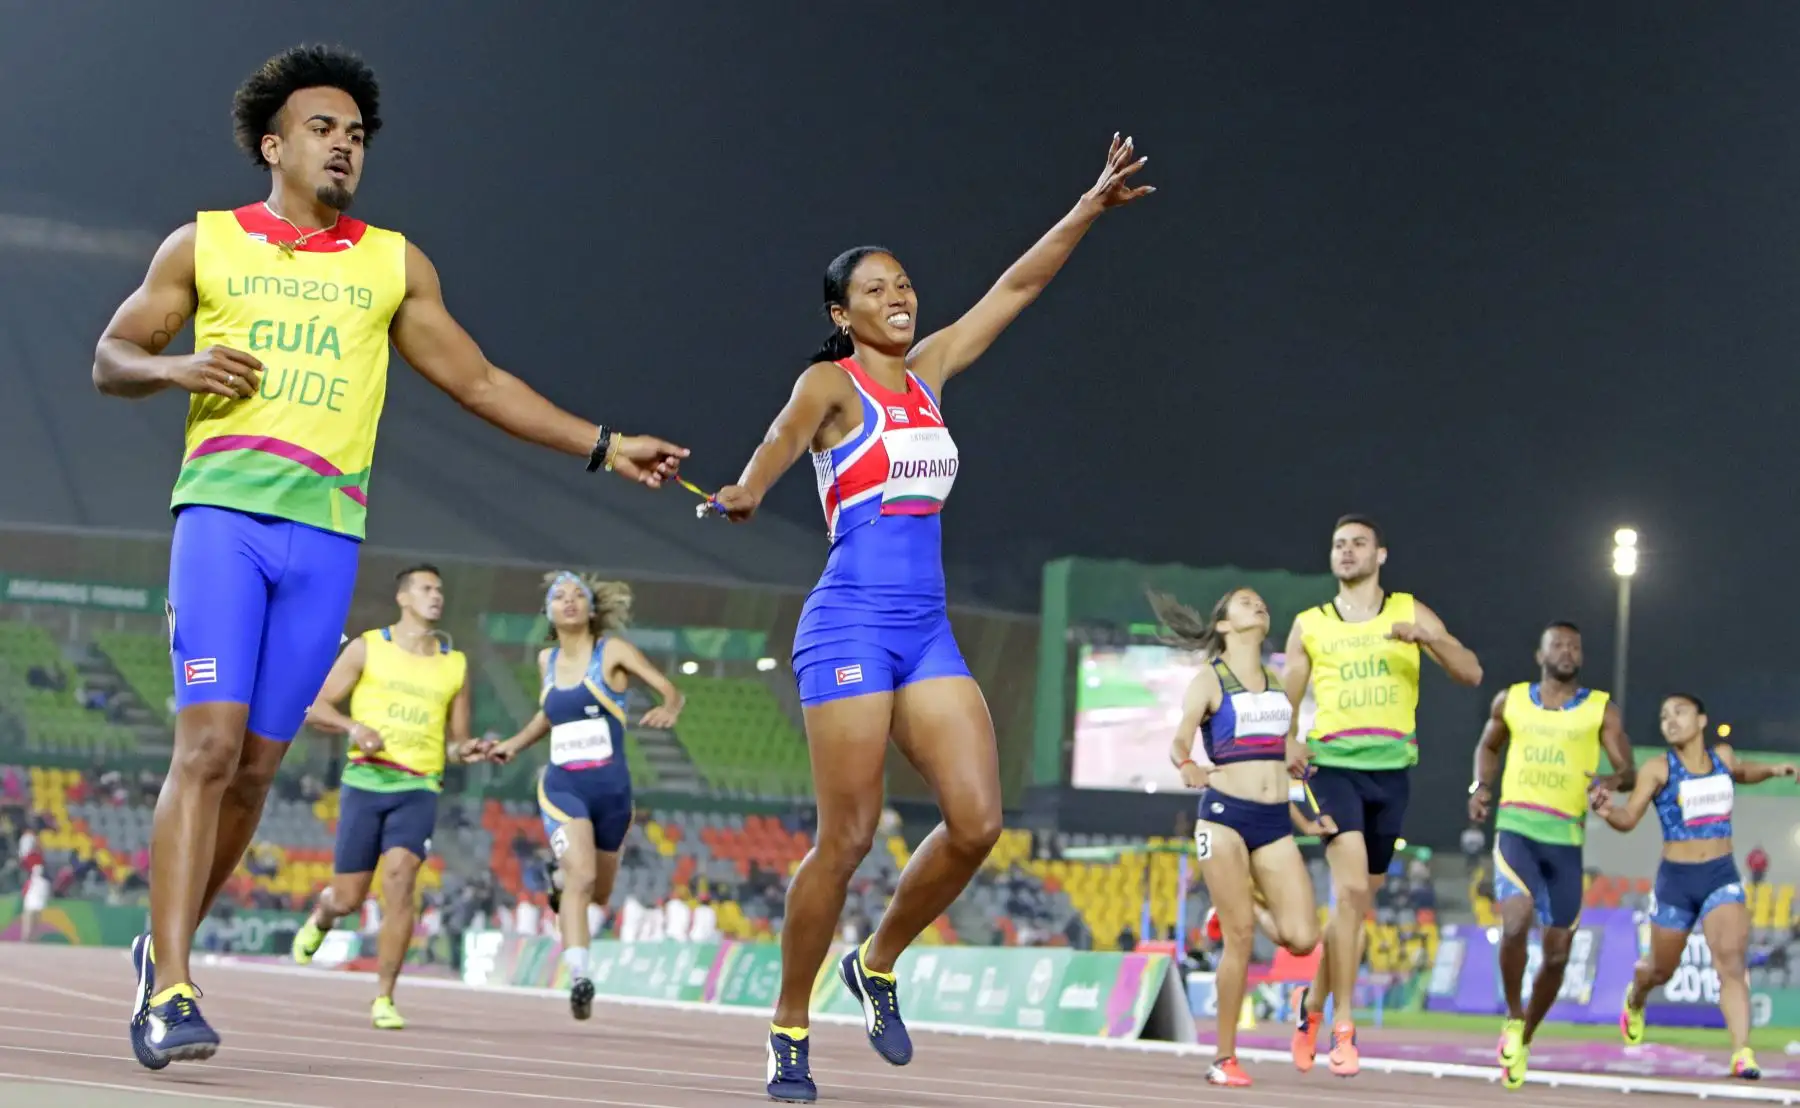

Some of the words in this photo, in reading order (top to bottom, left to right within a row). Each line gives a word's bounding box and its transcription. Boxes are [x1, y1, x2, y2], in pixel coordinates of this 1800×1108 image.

[248, 315, 341, 361] GUÍA
[259, 366, 349, 413] UIDE
[891, 458, 957, 479] DURAND
[1340, 653, 1392, 682] GUÍA
[1338, 684, 1400, 711] GUIDE
[387, 701, 430, 726] GUÍA
[1524, 742, 1566, 766] GUÍA
[1199, 831, 1209, 858] 3
